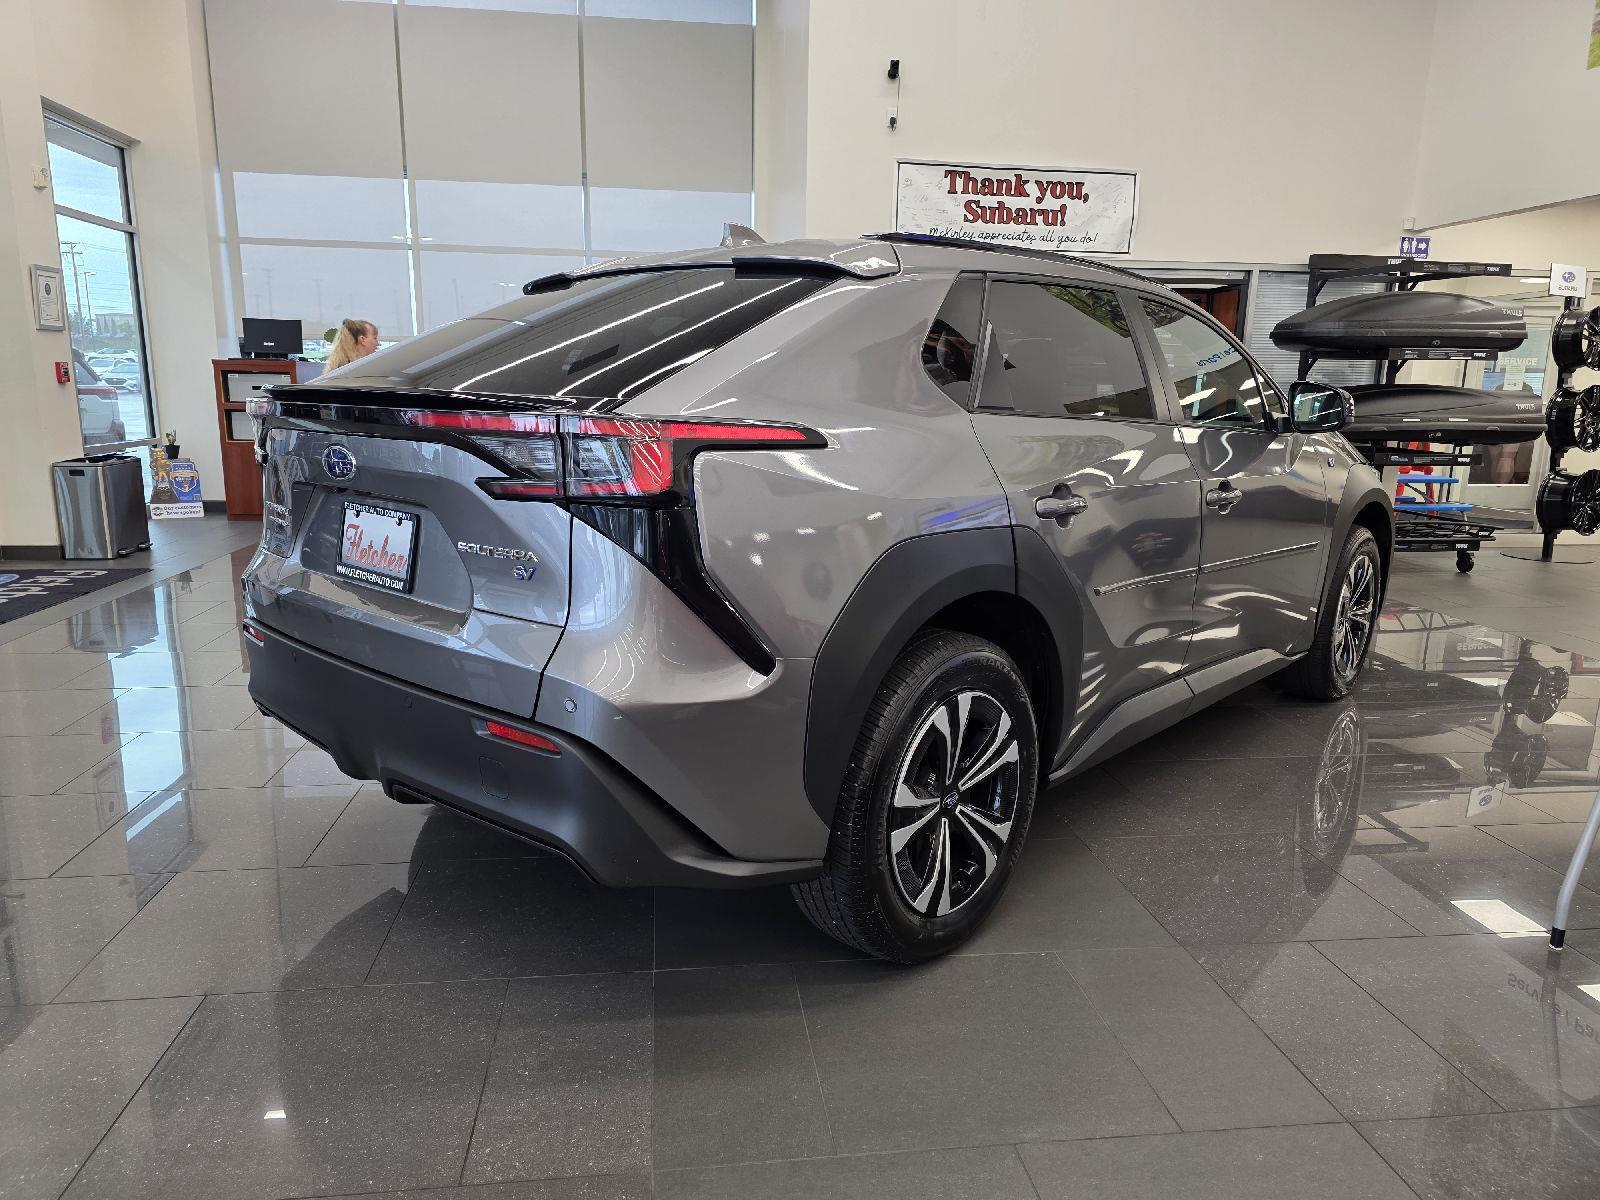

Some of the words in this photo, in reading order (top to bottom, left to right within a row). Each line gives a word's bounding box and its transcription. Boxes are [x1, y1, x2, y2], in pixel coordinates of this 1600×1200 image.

[944, 170, 1030, 197] Thank
[1035, 180, 1089, 204] you,
[963, 199, 1067, 227] Subaru!
[977, 229, 1037, 244] appreciates
[1039, 229, 1055, 243] all
[1056, 235, 1078, 249] you
[1080, 231, 1098, 245] do!
[1501, 308, 1523, 317] THULE
[344, 501, 369, 513] FLETCHER
[384, 509, 411, 521] COMPANY
[345, 523, 407, 573] Fletcher
[457, 541, 539, 563] SOLTERRA
[336, 564, 404, 590] WWW.FLETCHERAUTO.COM
